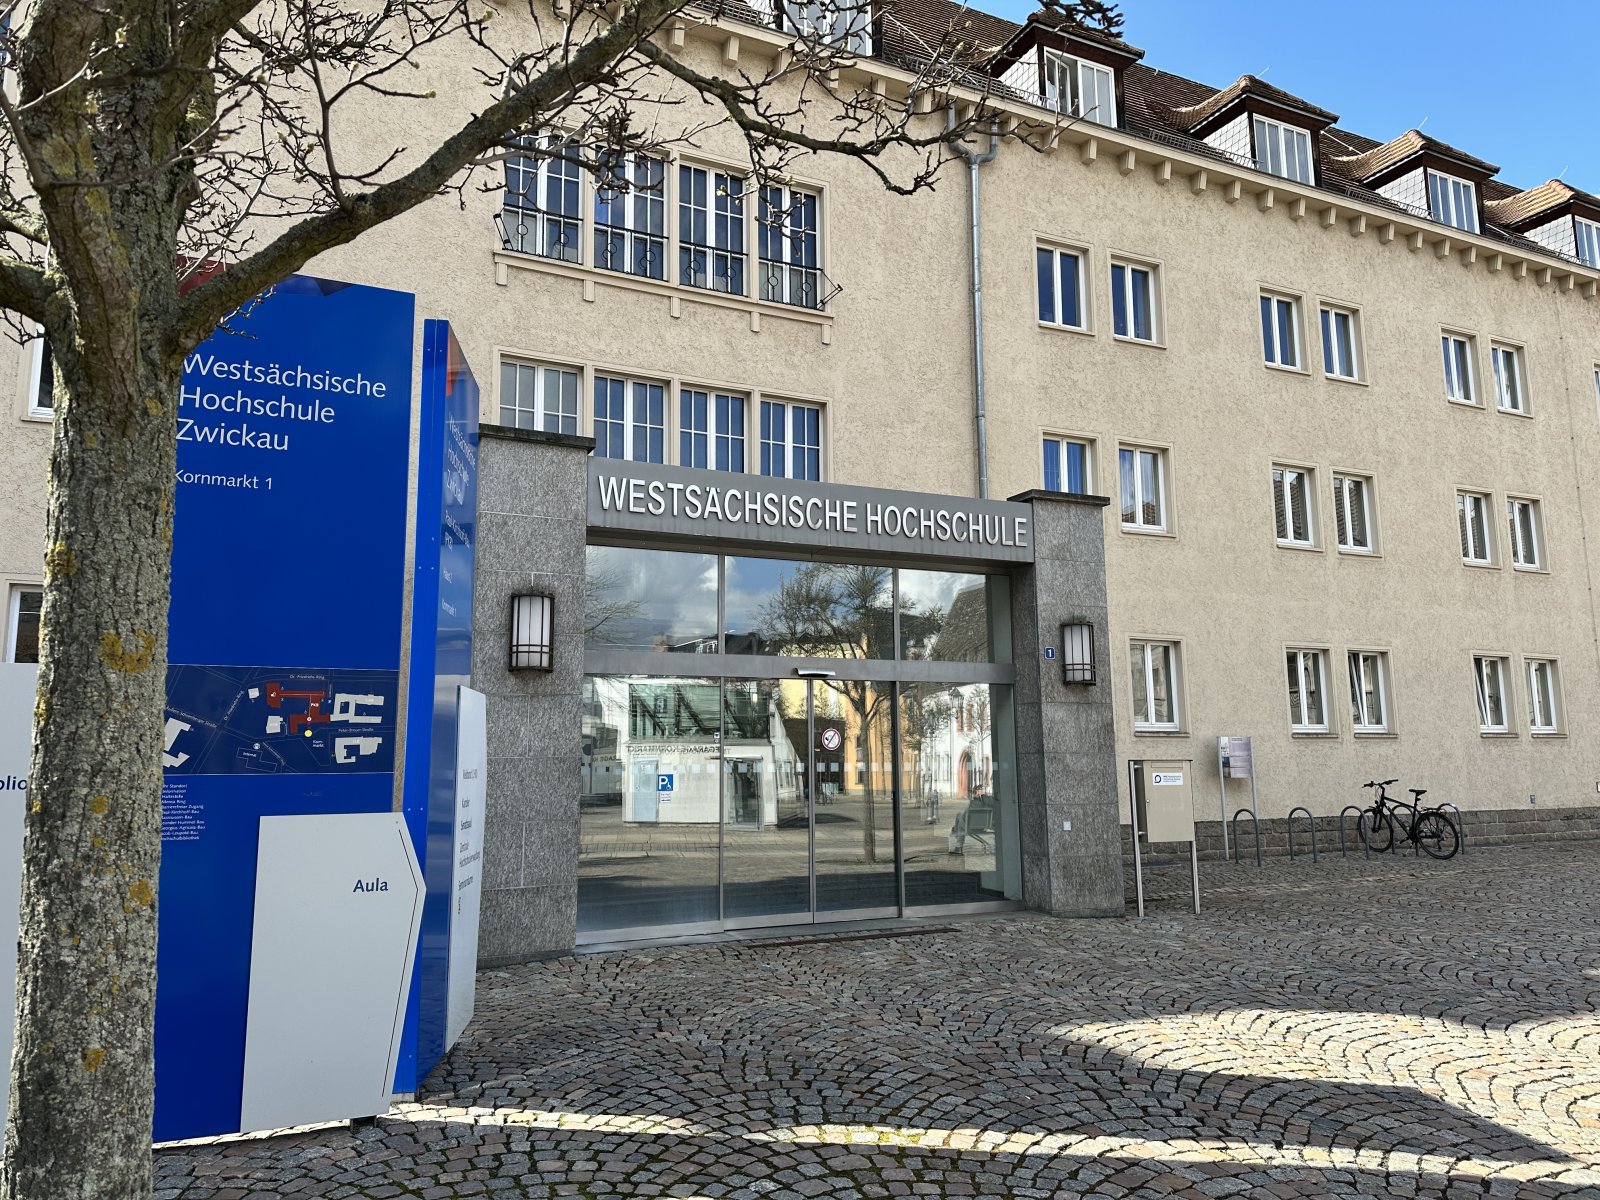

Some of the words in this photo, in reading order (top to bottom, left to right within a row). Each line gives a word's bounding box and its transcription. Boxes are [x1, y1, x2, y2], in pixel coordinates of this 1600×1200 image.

[184, 353, 386, 398] Westsächsische
[179, 384, 335, 423] Hochschule
[175, 418, 289, 450] Zwickau
[265, 477, 272, 490] 1
[598, 475, 858, 533] WESTSÄCHSISCHE
[866, 502, 1027, 547] HOCHSCHULE
[1047, 648, 1052, 658] 1
[352, 877, 389, 893] Aula
